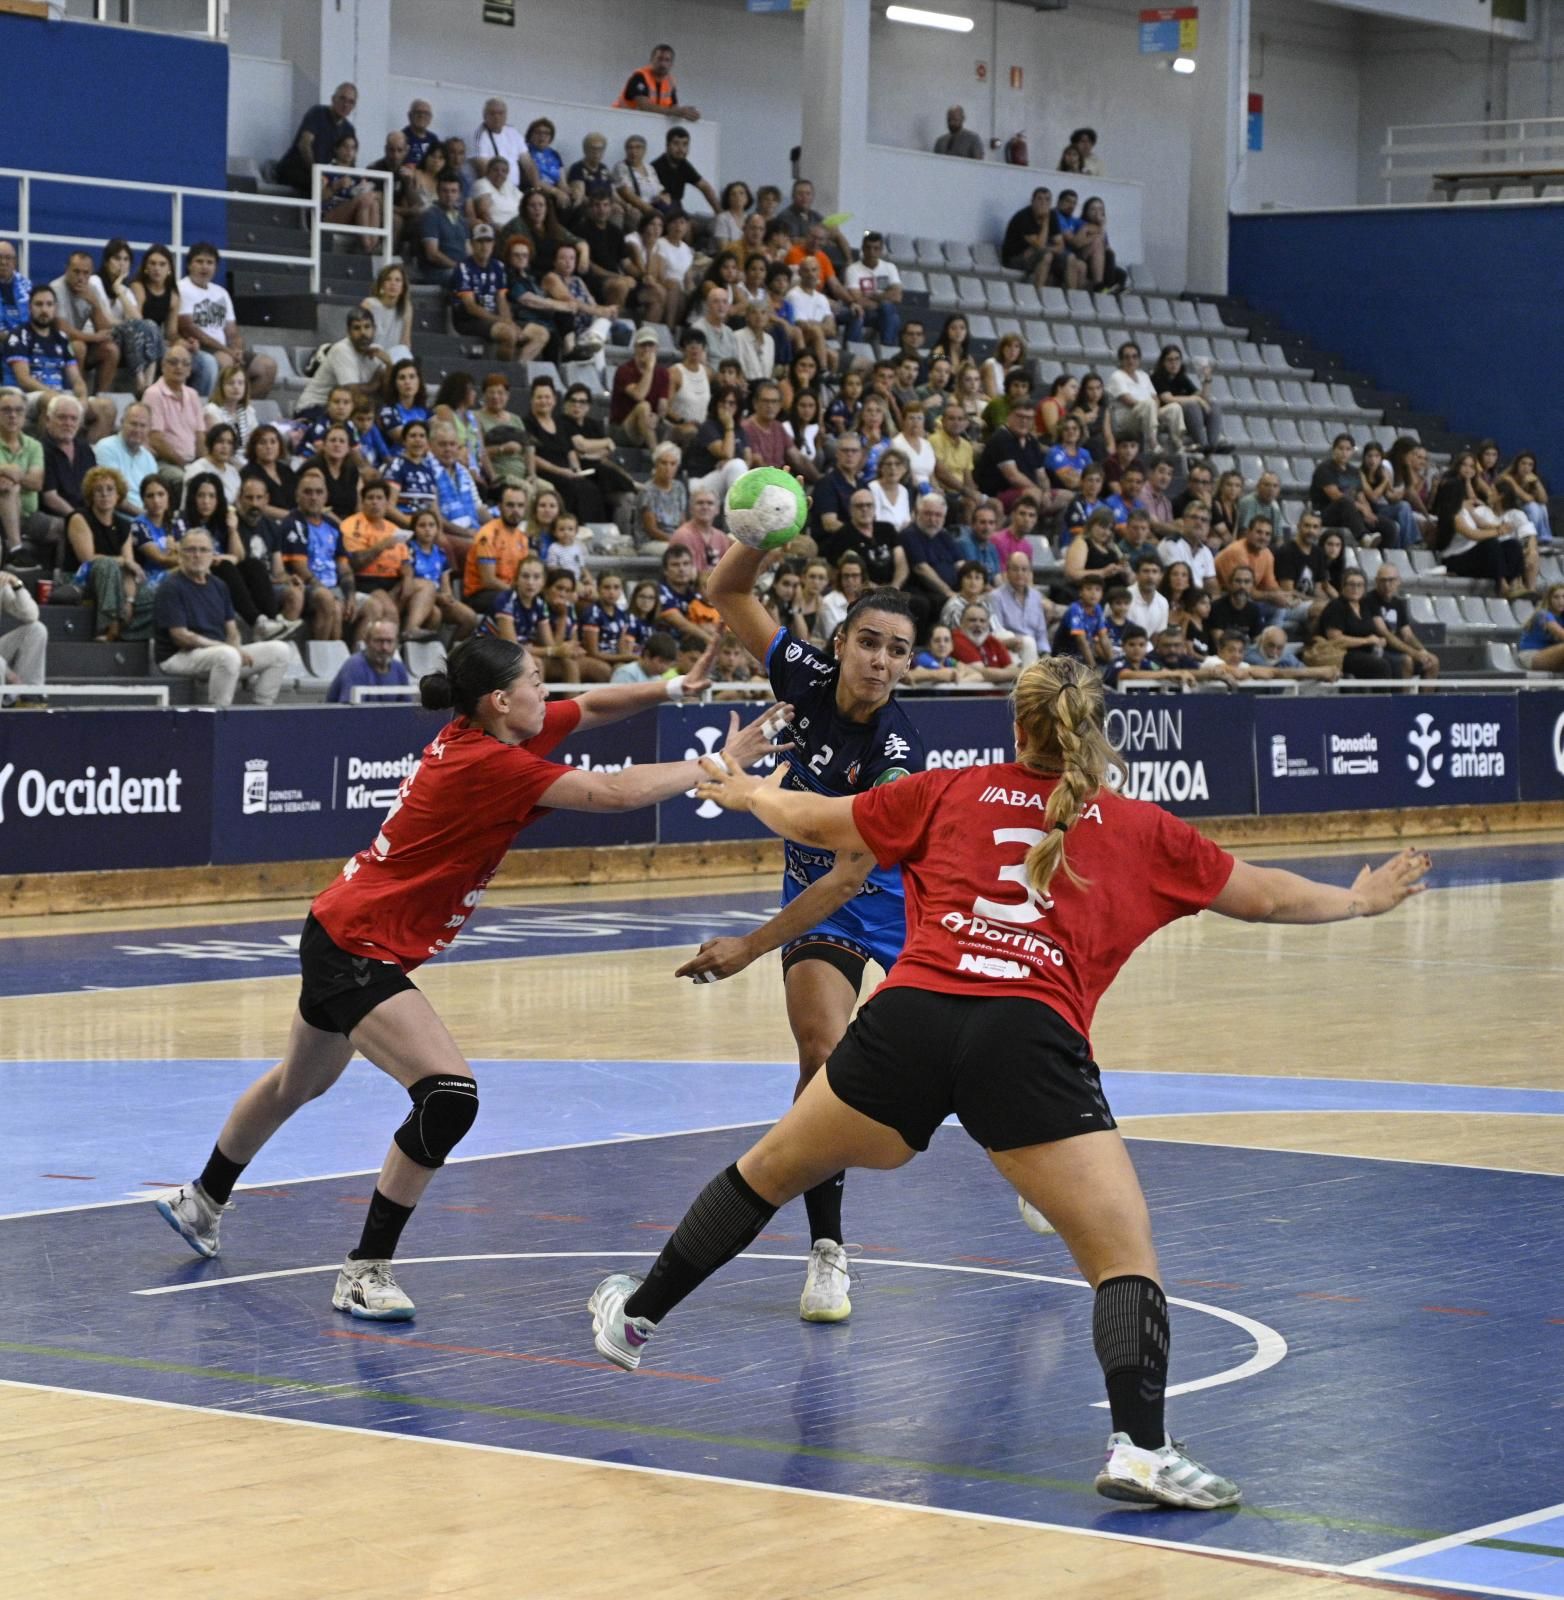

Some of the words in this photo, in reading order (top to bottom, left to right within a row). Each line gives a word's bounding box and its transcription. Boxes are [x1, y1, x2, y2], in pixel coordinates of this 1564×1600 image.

[1332, 732, 1377, 752] Donostia
[1451, 722, 1500, 753] super
[808, 744, 834, 776] 2
[1333, 755, 1379, 775] Kirola
[1451, 752, 1505, 777] amara
[18, 766, 182, 817] Occident
[972, 827, 1054, 924] 3
